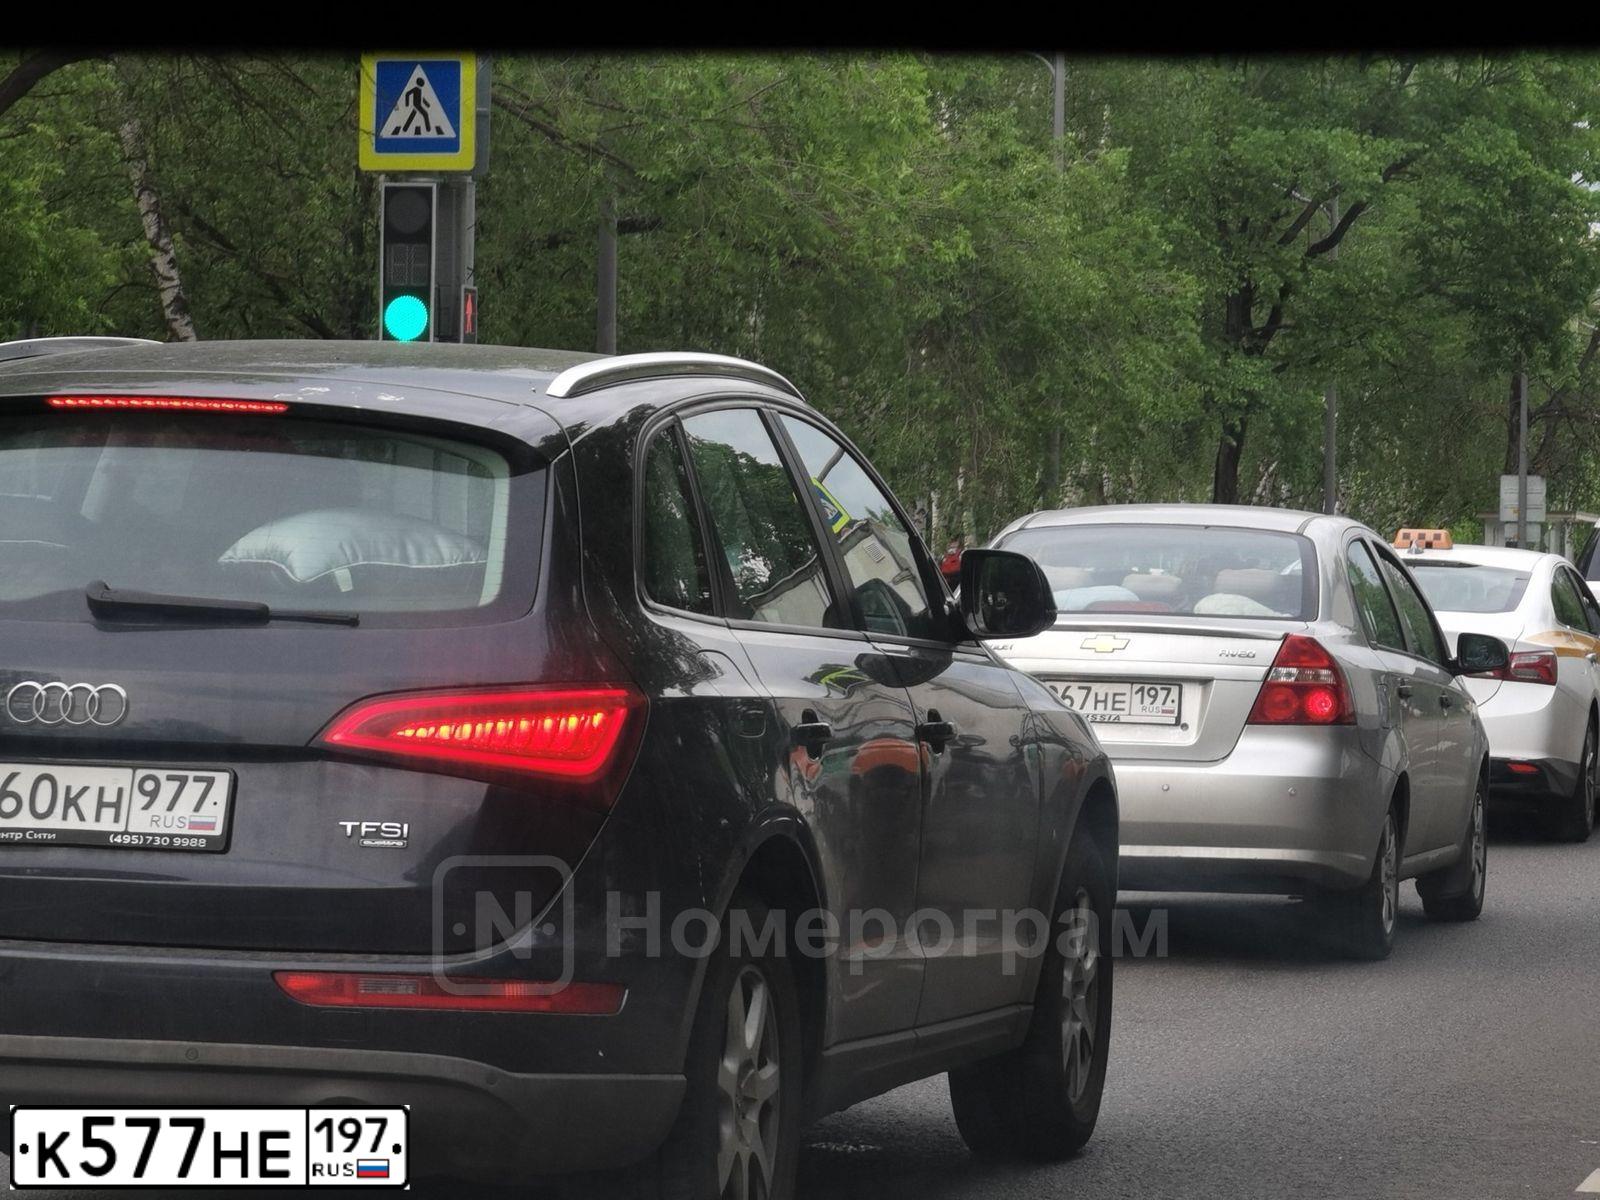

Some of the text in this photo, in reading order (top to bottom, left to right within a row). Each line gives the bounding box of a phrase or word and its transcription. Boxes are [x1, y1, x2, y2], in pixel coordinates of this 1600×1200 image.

[1134, 686, 1172, 706] 197
[1141, 706, 1161, 714] RUS
[136, 773, 216, 813] 977
[150, 814, 187, 829] RUS
[0, 830, 56, 841] нтр Сити
[339, 821, 409, 838] TFSI
[172, 837, 207, 848] 9988
